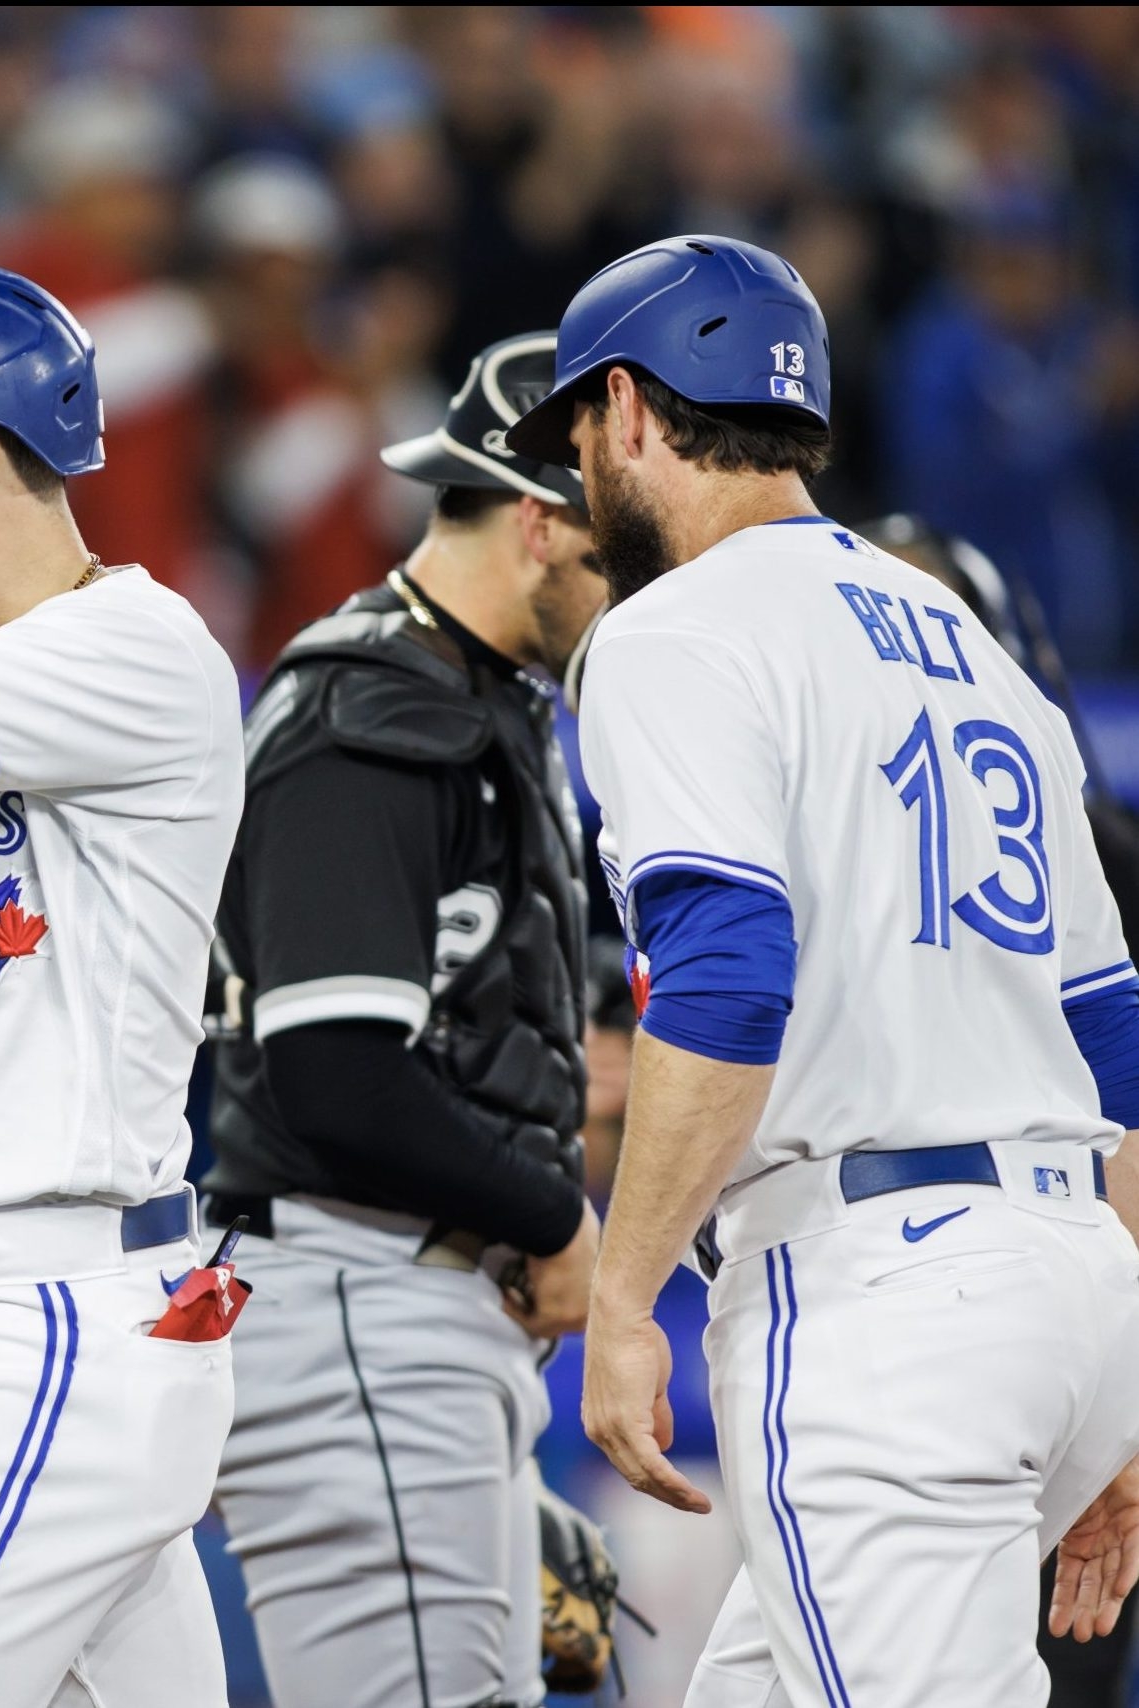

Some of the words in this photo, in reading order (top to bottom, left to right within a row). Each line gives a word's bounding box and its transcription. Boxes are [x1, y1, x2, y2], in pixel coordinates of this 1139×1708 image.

[770, 341, 805, 376] 13
[835, 582, 975, 686] BELT
[878, 704, 1055, 955] 13
